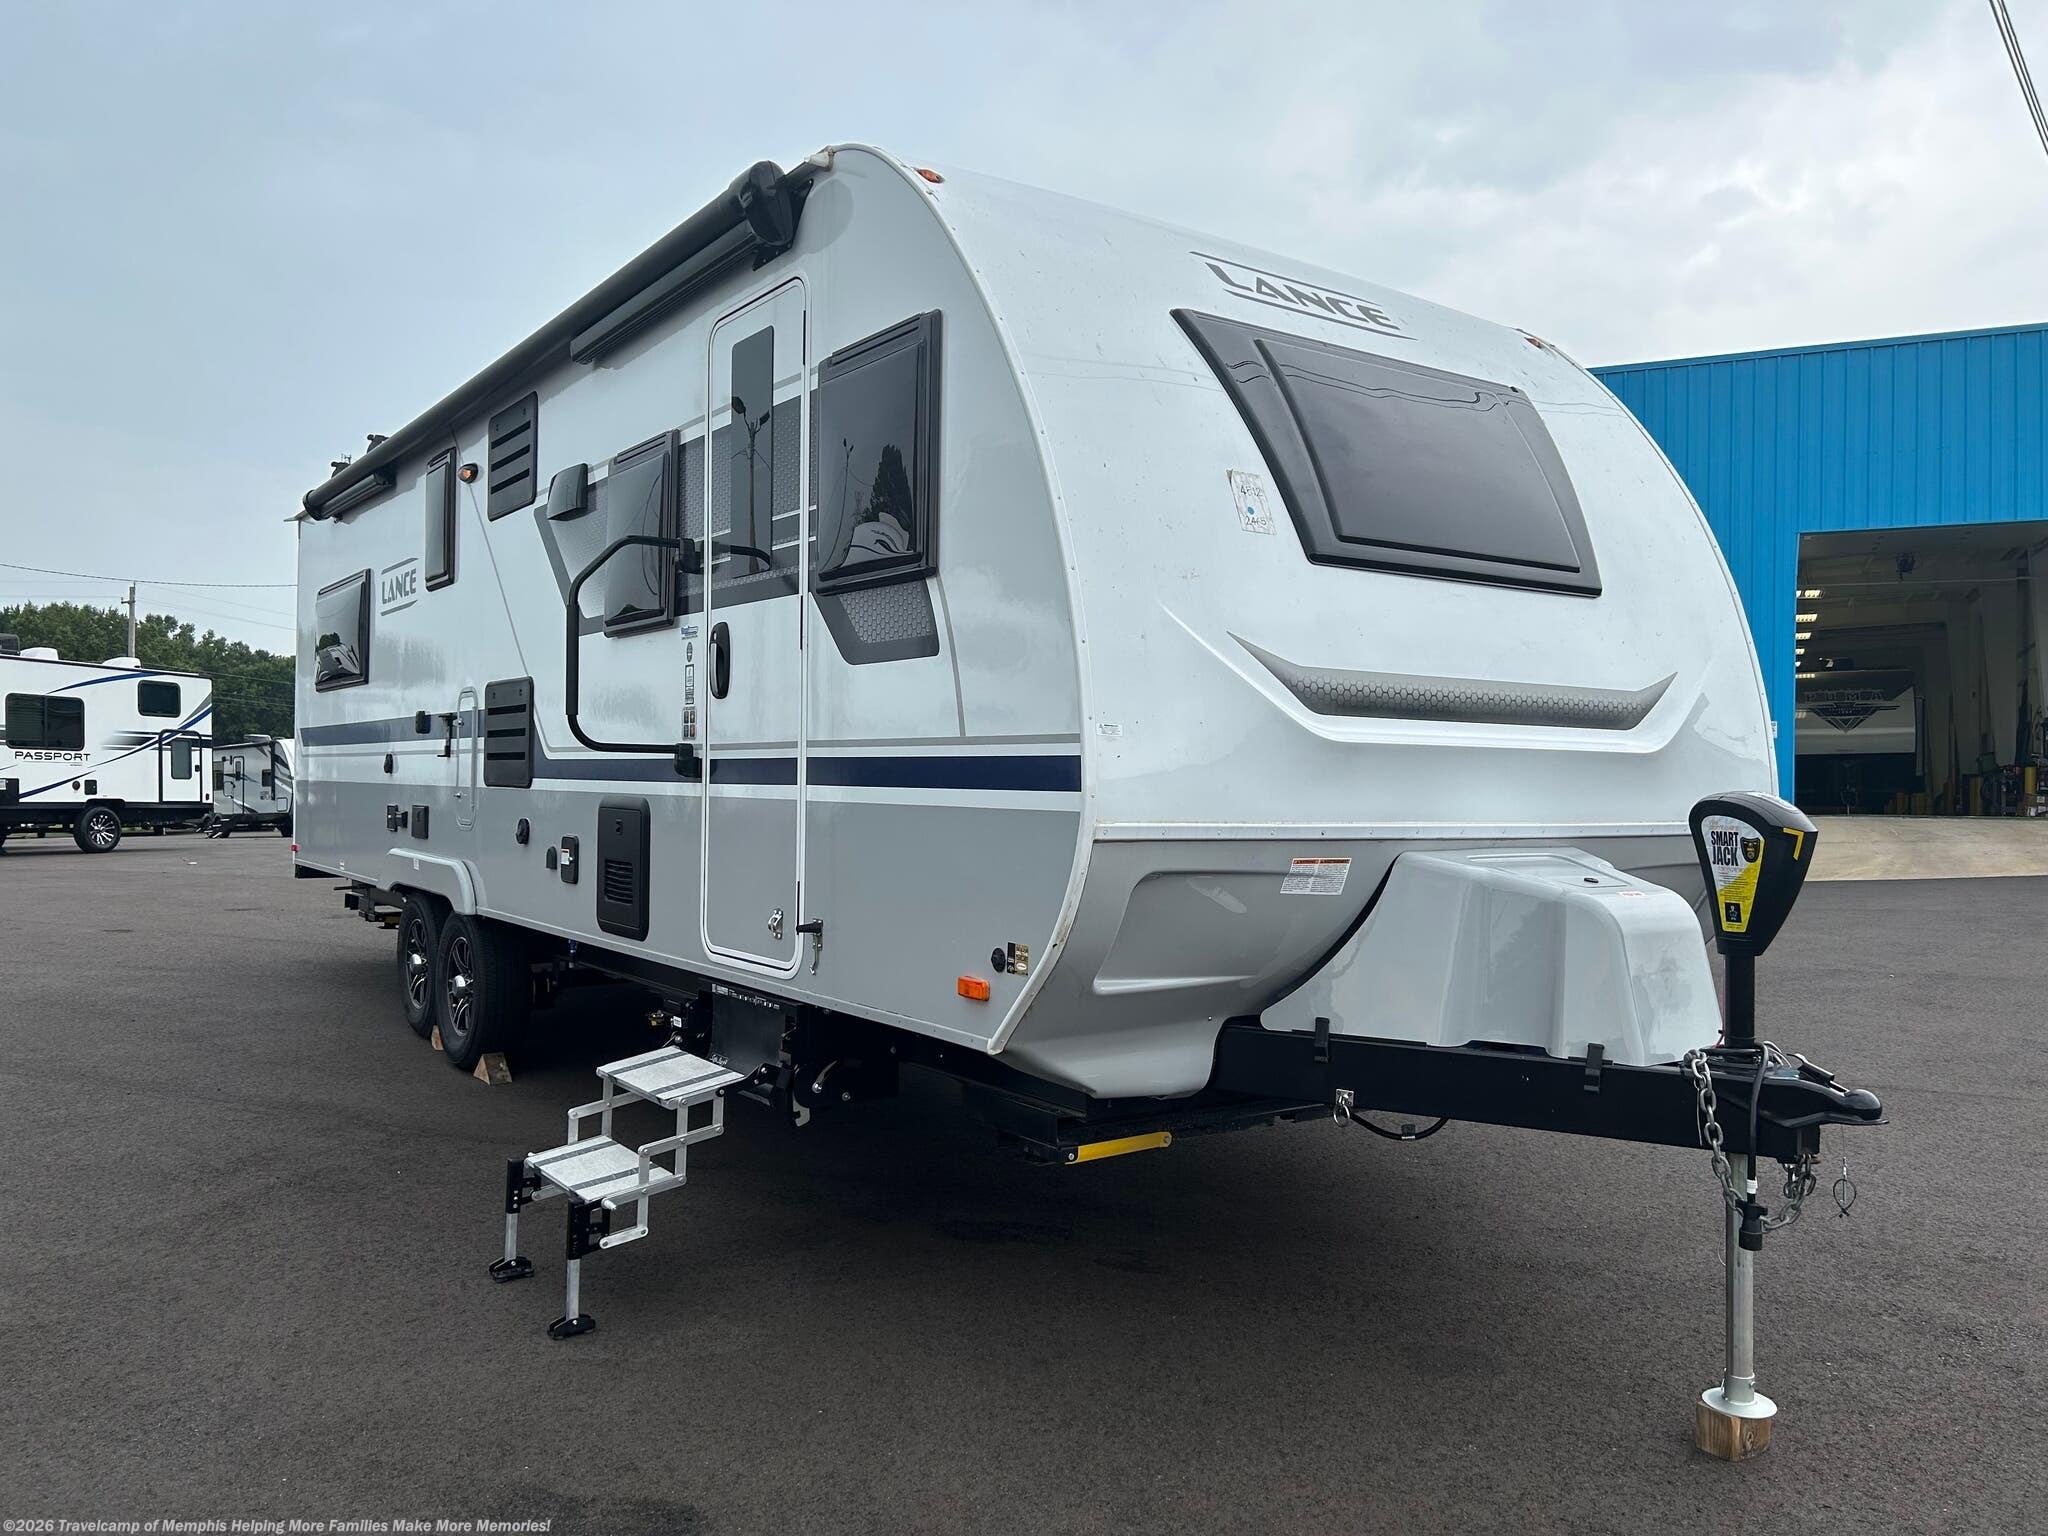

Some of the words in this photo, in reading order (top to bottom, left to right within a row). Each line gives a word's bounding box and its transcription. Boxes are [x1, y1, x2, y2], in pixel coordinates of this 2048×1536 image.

[1204, 261, 1401, 331] LANCE
[381, 567, 417, 605] LANCE
[14, 751, 91, 761] PASSPORT
[1710, 830, 1739, 847] SMART
[1712, 845, 1739, 867] JACK
